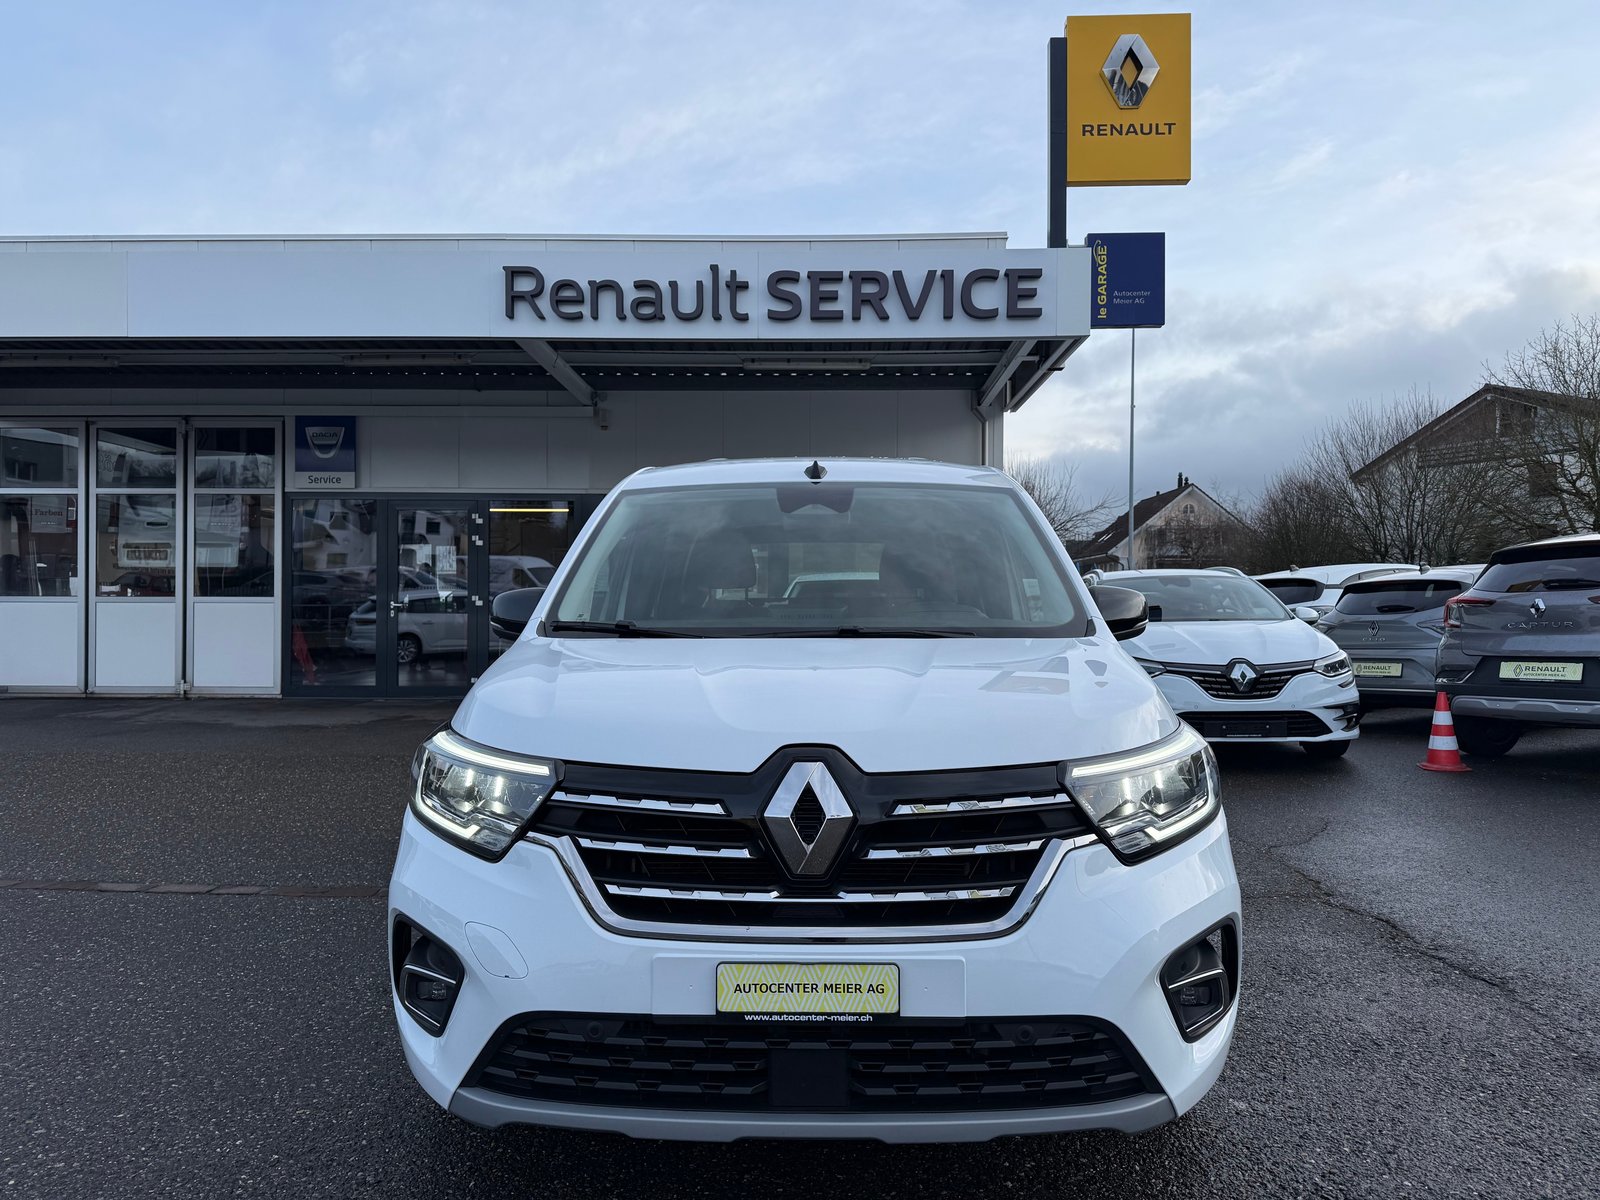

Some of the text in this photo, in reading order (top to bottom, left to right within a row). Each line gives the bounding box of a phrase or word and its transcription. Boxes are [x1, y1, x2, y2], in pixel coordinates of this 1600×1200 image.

[1081, 123, 1176, 137] RENAULT
[1097, 245, 1107, 319] le GARAGE
[502, 264, 1043, 322] Renault SERVICE
[307, 475, 342, 484] Service
[733, 982, 885, 994] AUTOCENTER MEIER AG
[744, 1013, 873, 1022] www.autocenter-meier.ch
